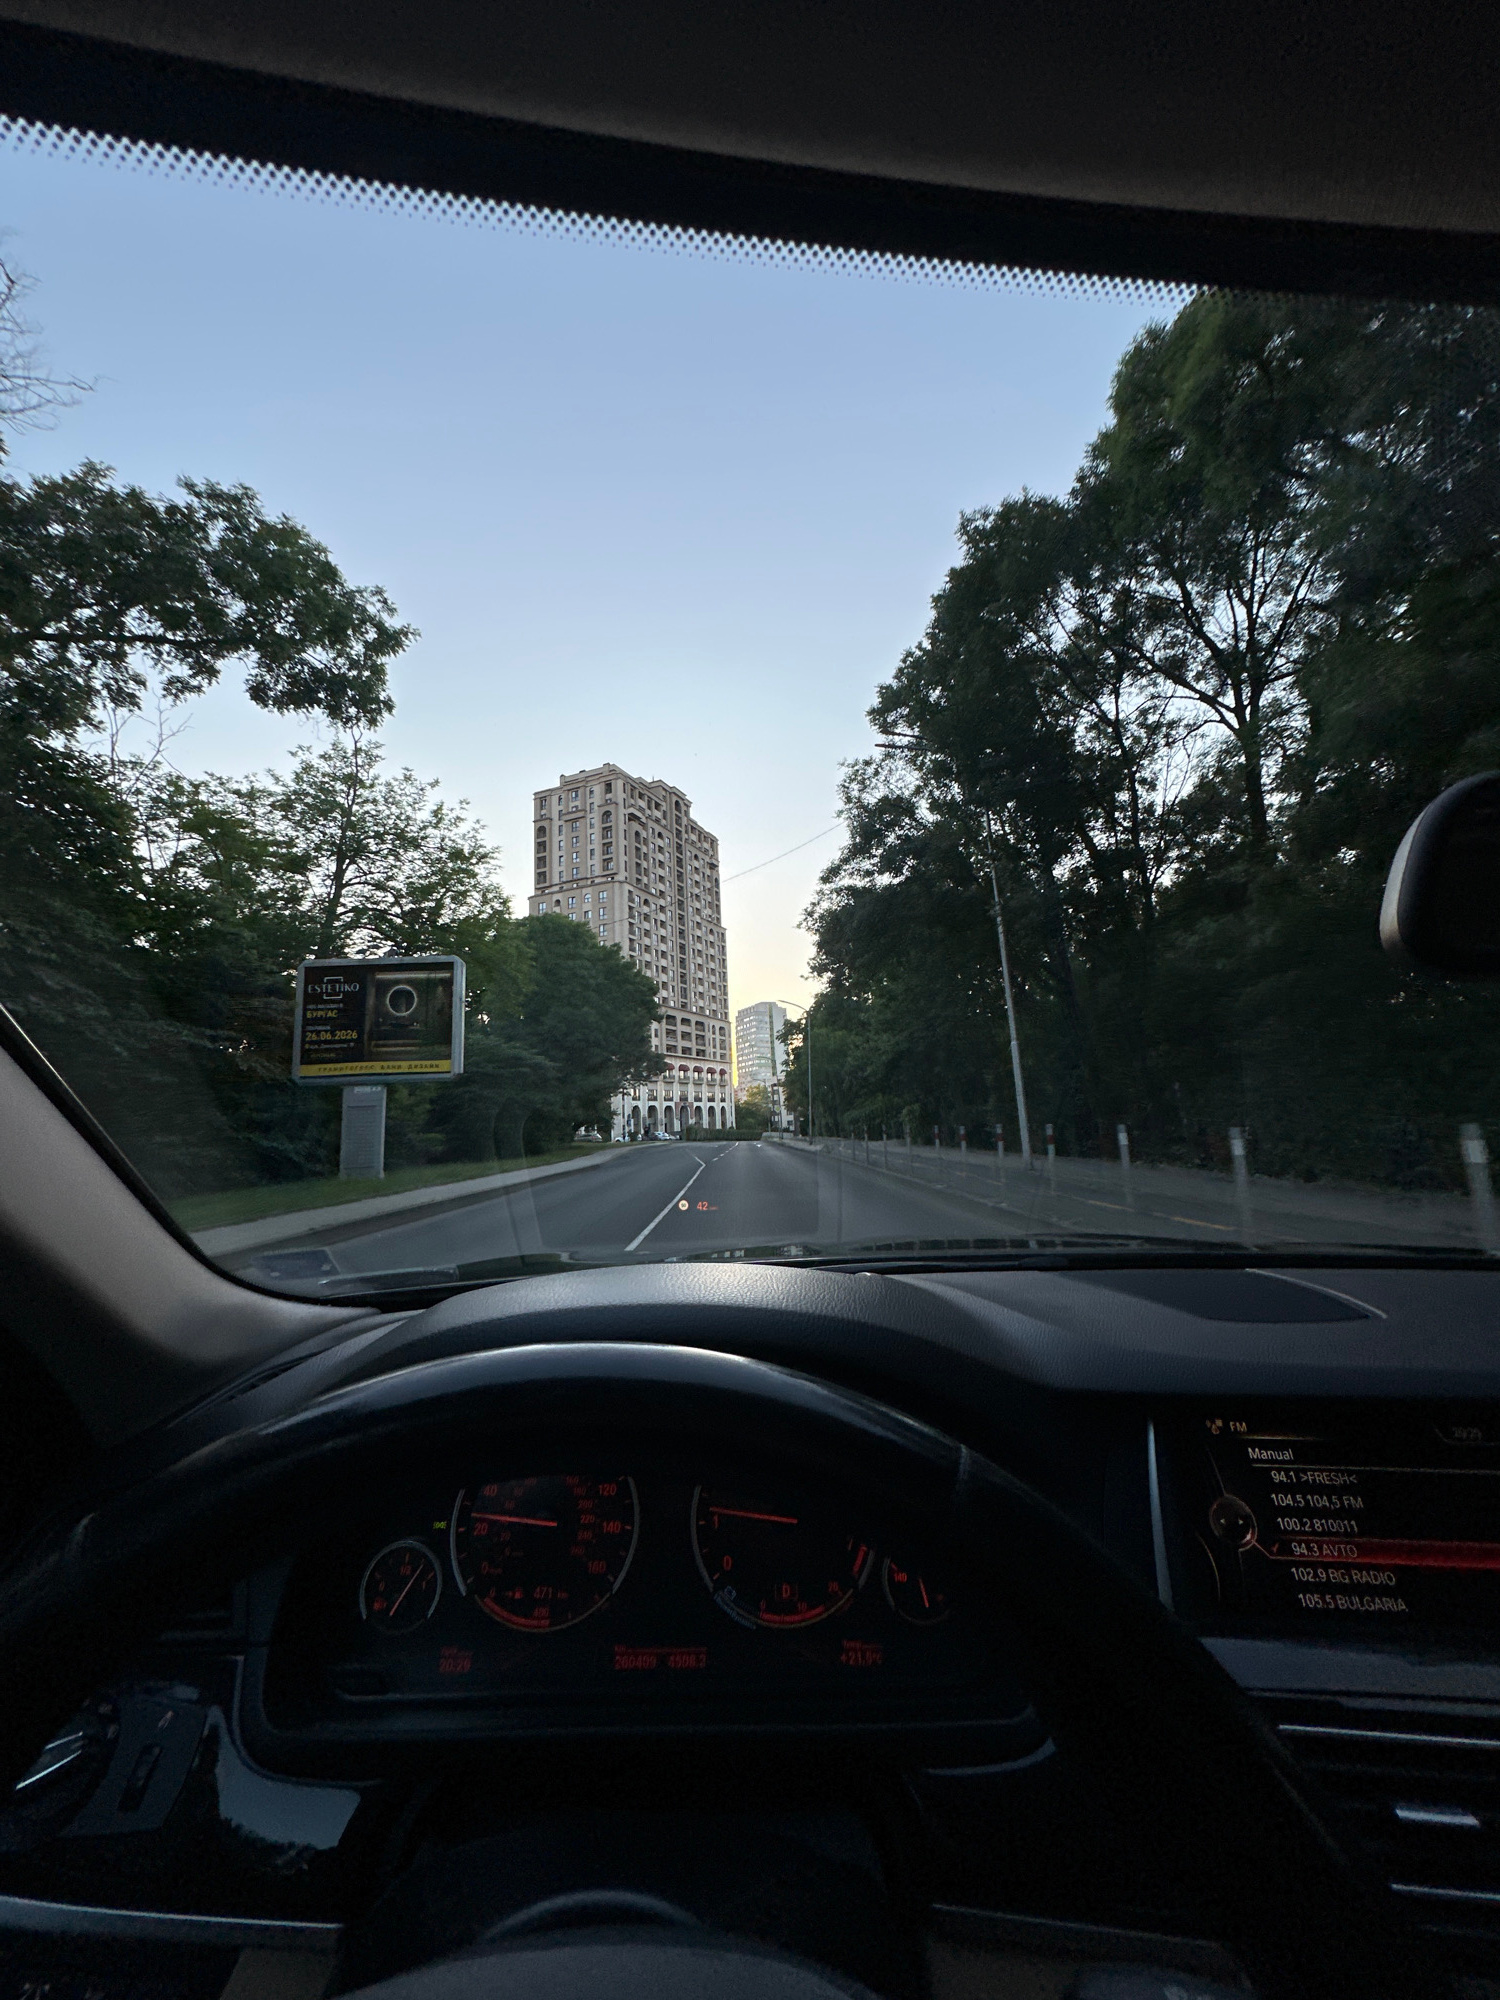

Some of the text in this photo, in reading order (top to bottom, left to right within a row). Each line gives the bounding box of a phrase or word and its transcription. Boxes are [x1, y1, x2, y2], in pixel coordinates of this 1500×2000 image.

[308, 982, 360, 993] ESTETIKO
[306, 1010, 338, 1018] БУРГАС
[306, 1030, 358, 1041] 26.06.2026
[696, 1201, 709, 1211] 42
[1229, 1421, 1248, 1433] FM
[1247, 1446, 1294, 1460] Manual
[1270, 1470, 1359, 1486] 94.1 >FRESH<
[482, 1483, 499, 1497] 40
[598, 1482, 618, 1496] 120
[1270, 1492, 1305, 1508] 104.5
[1343, 1496, 1364, 1510] FM
[473, 1521, 489, 1537] 20
[602, 1519, 622, 1534] 140
[1276, 1517, 1312, 1531] 100.2
[1291, 1542, 1359, 1558] 94.3 AVTO
[723, 1554, 733, 1571] 0
[1290, 1566, 1397, 1586] 102.9 BG RADIO
[533, 1585, 553, 1600] 471
[781, 1582, 792, 1599] D
[1298, 1593, 1408, 1612] 105.5 BULGARIA
